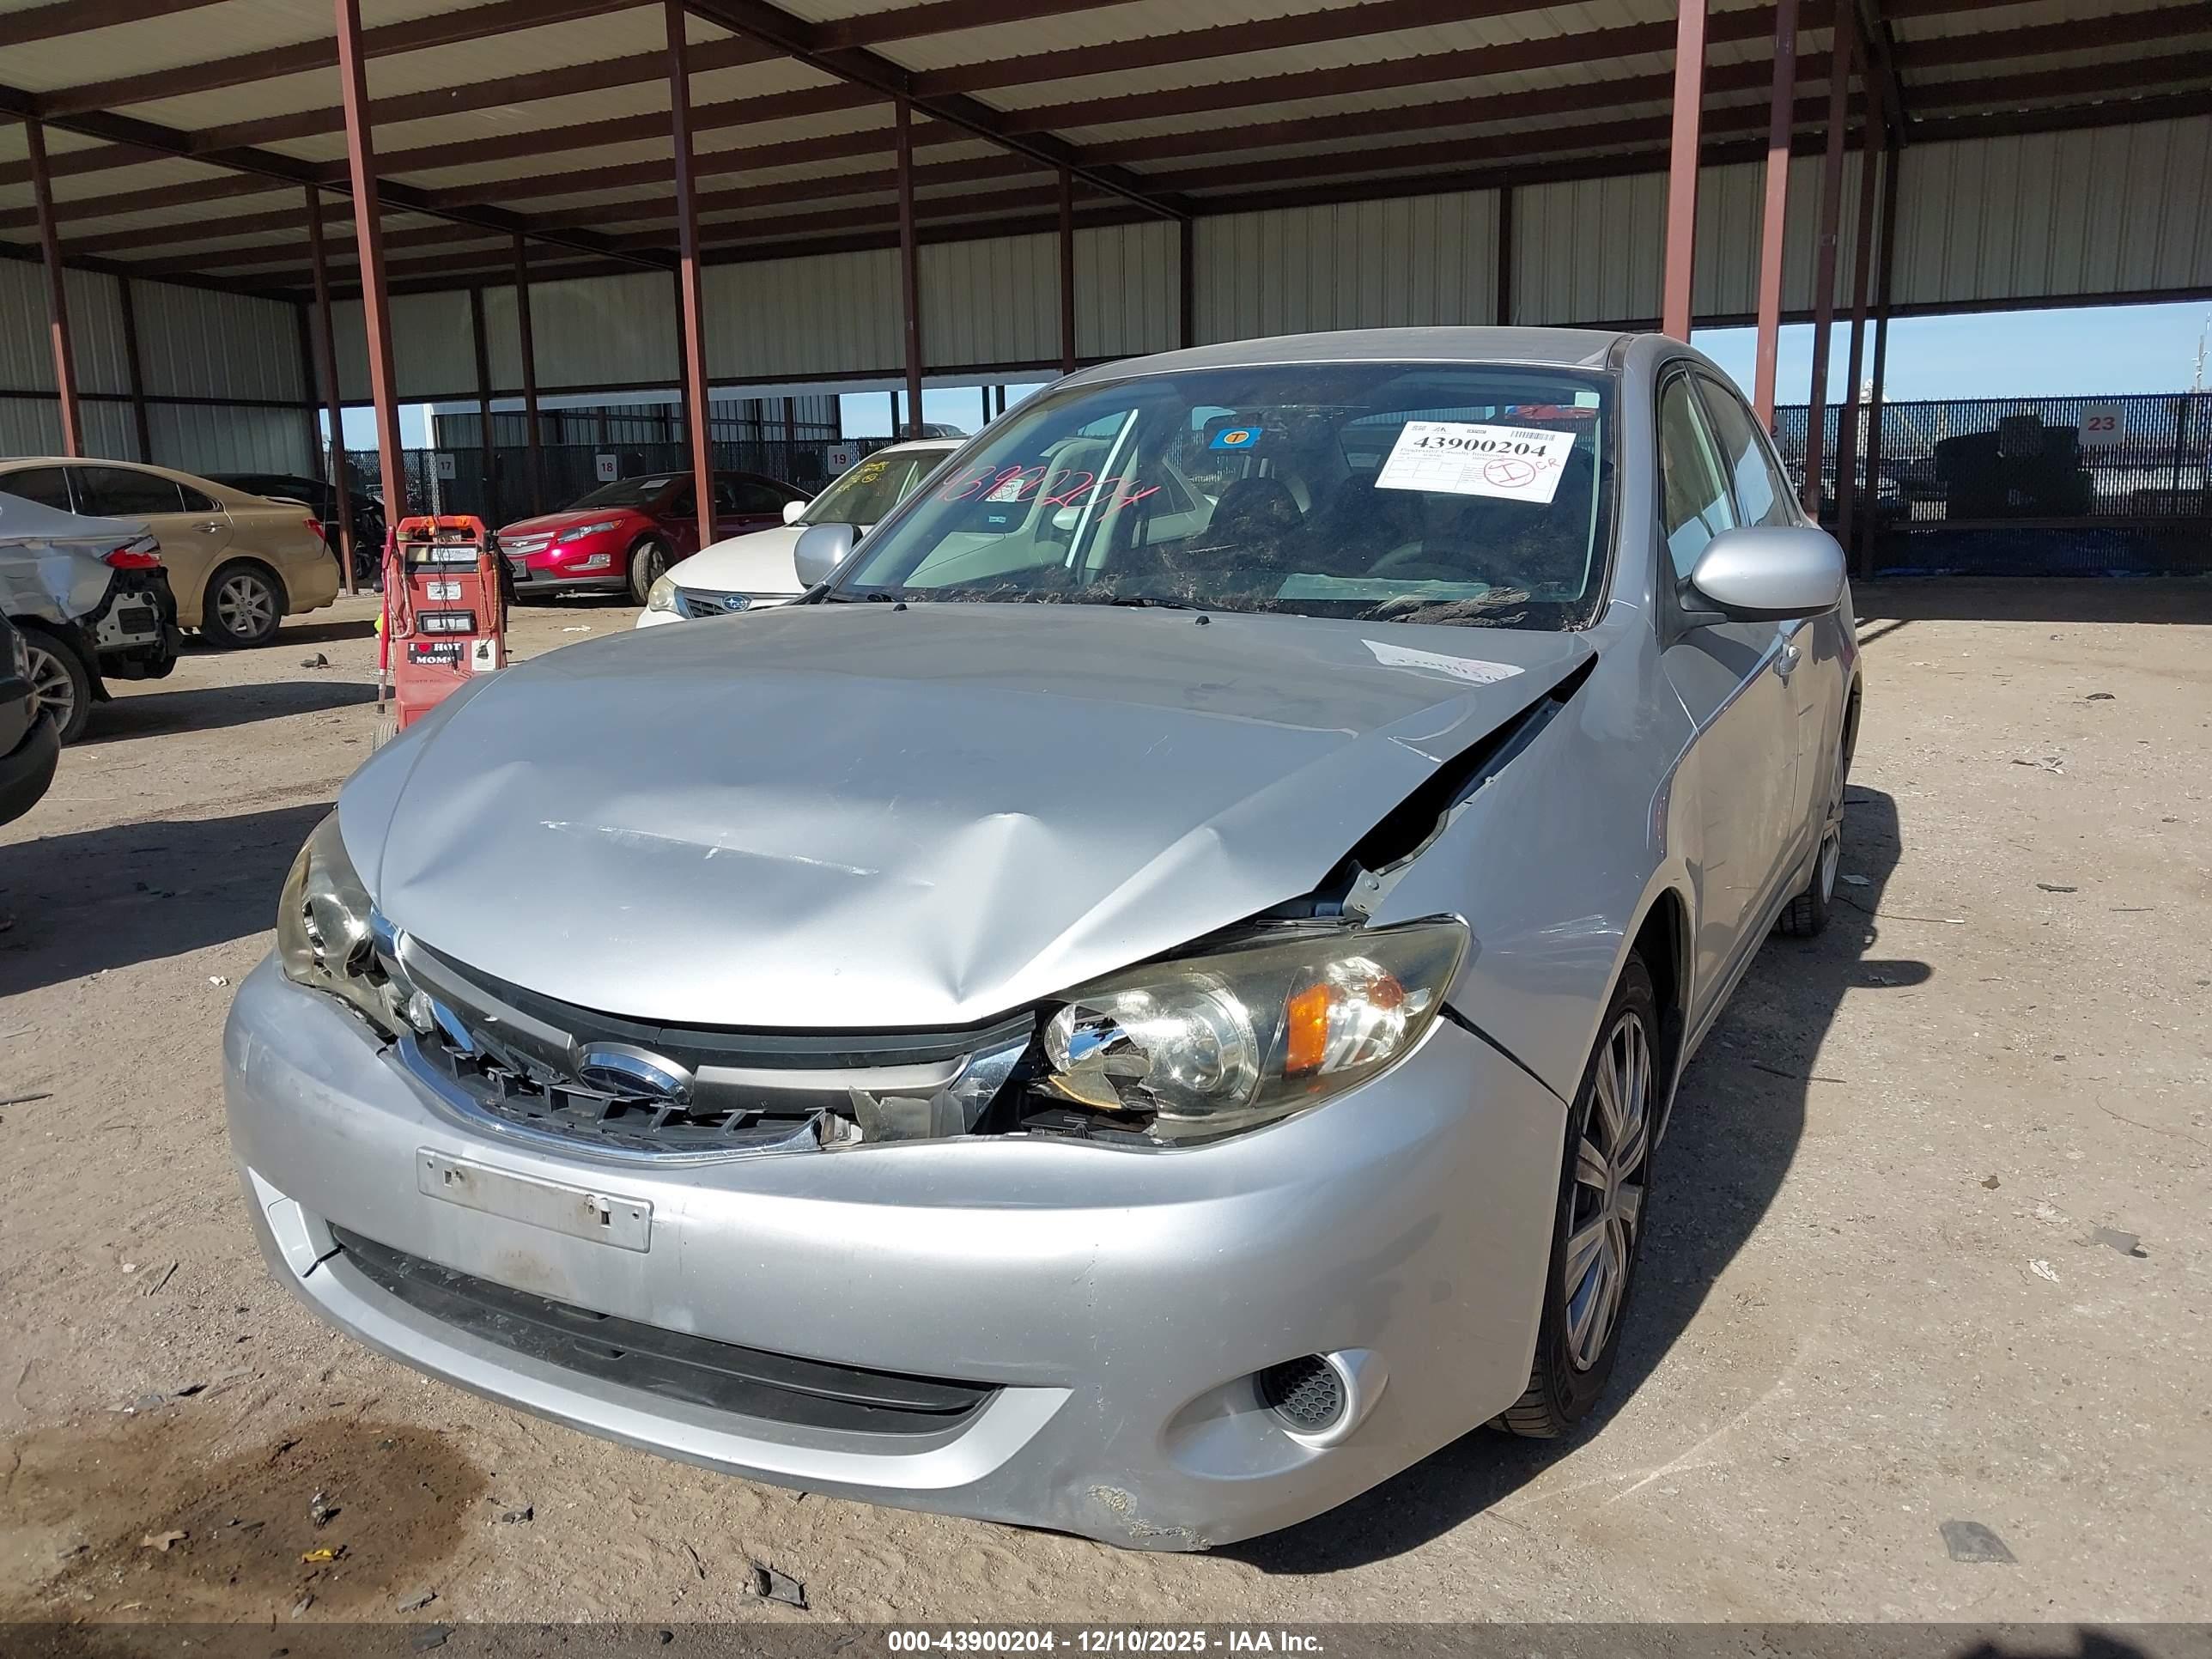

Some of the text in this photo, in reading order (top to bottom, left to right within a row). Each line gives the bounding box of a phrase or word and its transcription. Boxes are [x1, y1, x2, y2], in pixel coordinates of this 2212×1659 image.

[2088, 417, 2116, 432] 23
[1413, 436, 1547, 458] 43900204
[833, 453, 847, 465] 19
[441, 461, 451, 471] 17
[601, 462, 613, 471] 18
[410, 643, 416, 652] I
